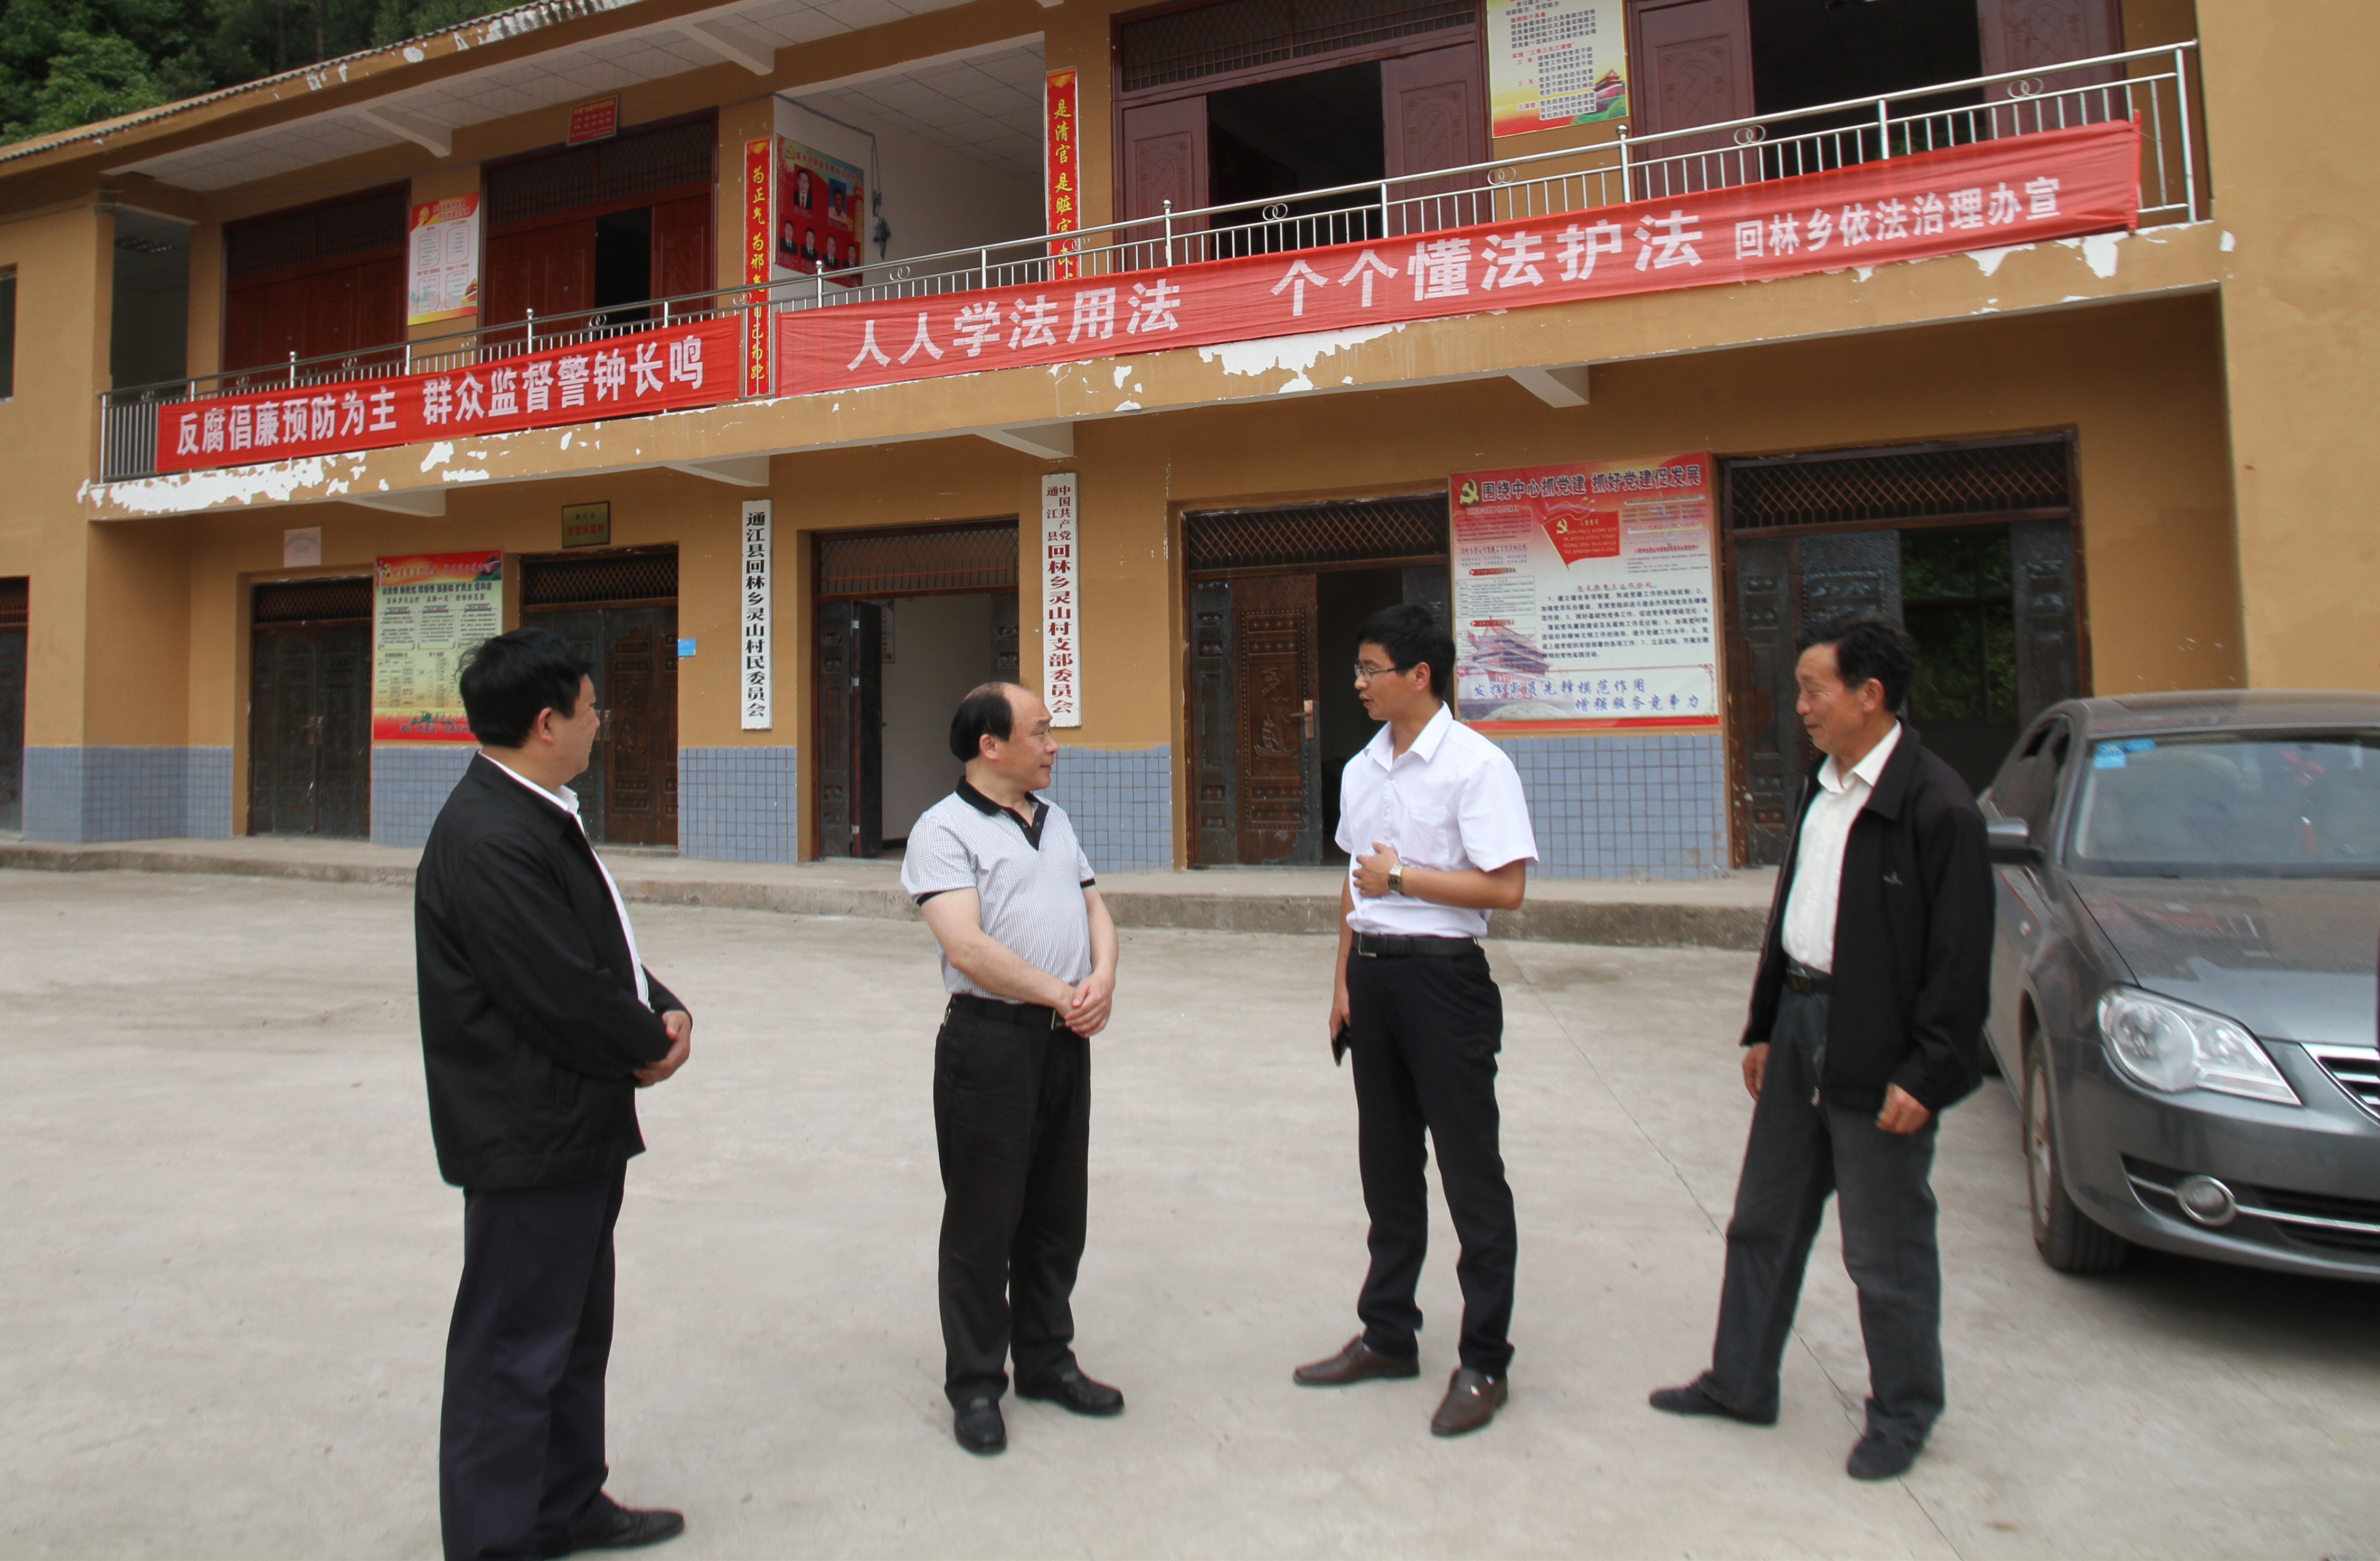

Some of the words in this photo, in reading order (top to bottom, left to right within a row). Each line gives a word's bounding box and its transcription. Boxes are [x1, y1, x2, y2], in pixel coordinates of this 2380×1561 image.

[846, 278, 1182, 372] 人人学法用法
[1270, 209, 1703, 316] 个个懂法护法
[1734, 176, 2061, 260] 回林乡依法治理办宣
[176, 386, 397, 457] 反腐倡廉预防为主
[422, 335, 703, 426] 群众监督警钟长鸣
[1046, 486, 1058, 542] 通江县
[1059, 485, 1071, 541] 中国共产党
[1481, 474, 1586, 502] 围绕中心抓党建
[1591, 464, 1702, 493] 抓好党建促发展
[744, 511, 766, 718] 通江县回林乡灵山村民委员会
[1047, 544, 1074, 714] 回林乡灵山村支部委员会
